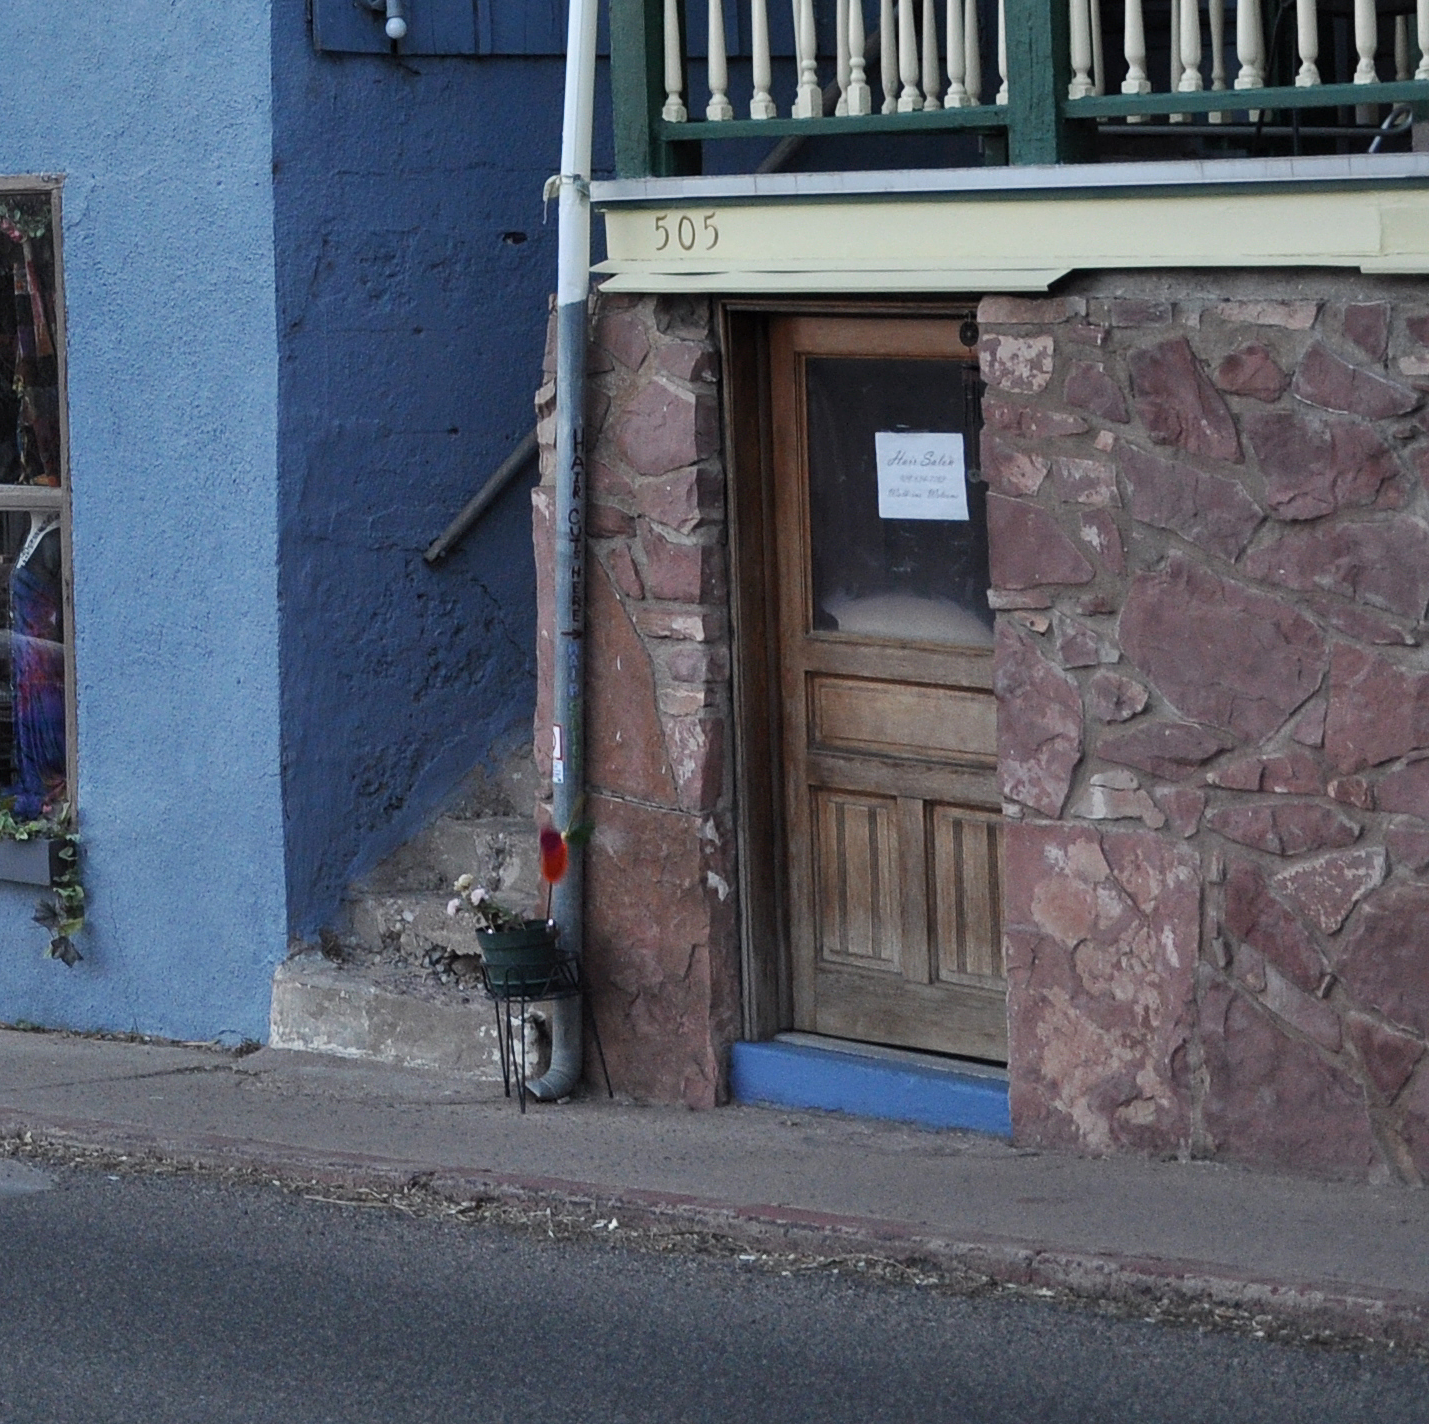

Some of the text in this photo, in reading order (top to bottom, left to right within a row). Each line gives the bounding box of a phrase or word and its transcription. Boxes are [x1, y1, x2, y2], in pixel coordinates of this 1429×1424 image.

[655, 212, 719, 251] 505
[571, 427, 584, 500] HAIR
[571, 565, 582, 623] HERE
